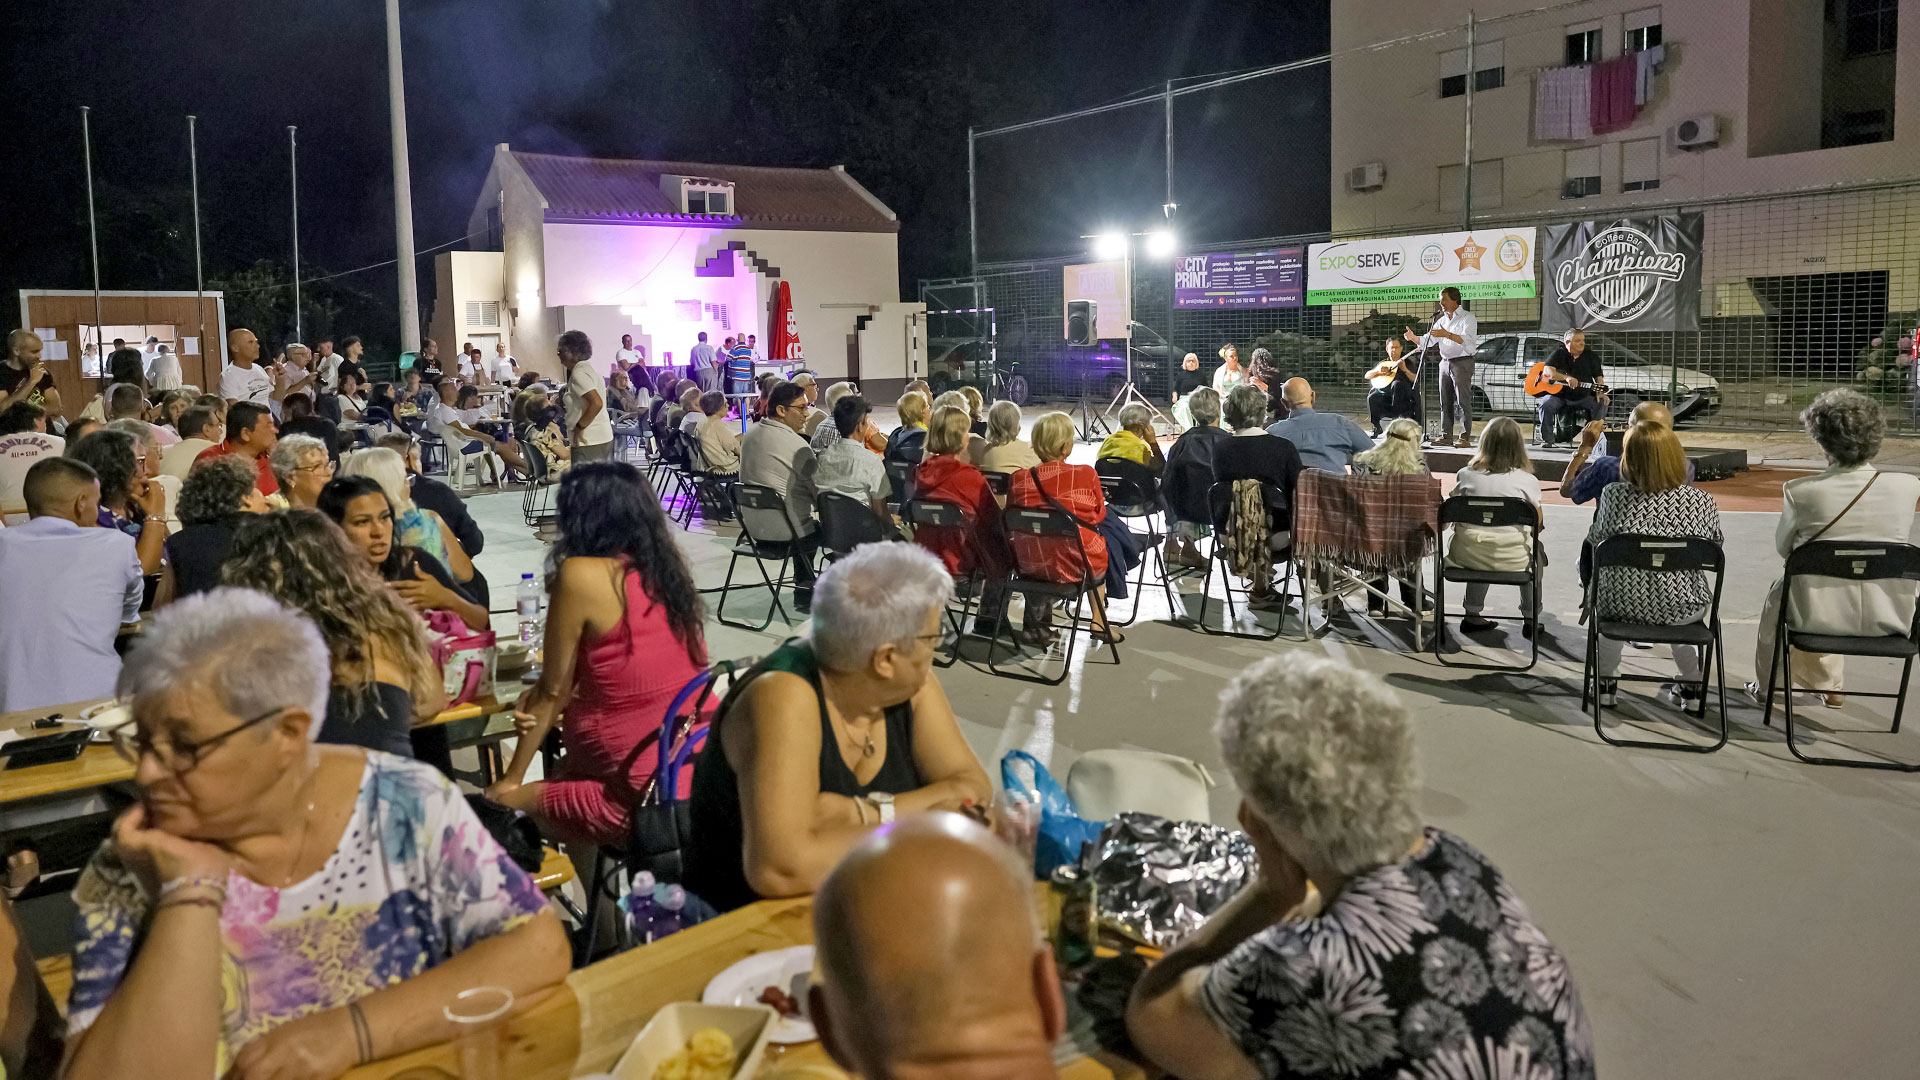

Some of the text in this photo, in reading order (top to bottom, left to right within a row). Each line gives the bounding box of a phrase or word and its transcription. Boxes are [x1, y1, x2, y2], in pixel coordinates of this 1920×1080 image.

[1595, 233, 1642, 248] Coffee Bar
[1185, 256, 1208, 272] CITY
[1320, 252, 1400, 271] EXPOSERVE
[1560, 250, 1681, 294] Champions
[1373, 287, 1407, 295] COMERCIAIS
[1387, 293, 1431, 301] EQUIPAMENTOS
[1620, 298, 1646, 318] Portugal
